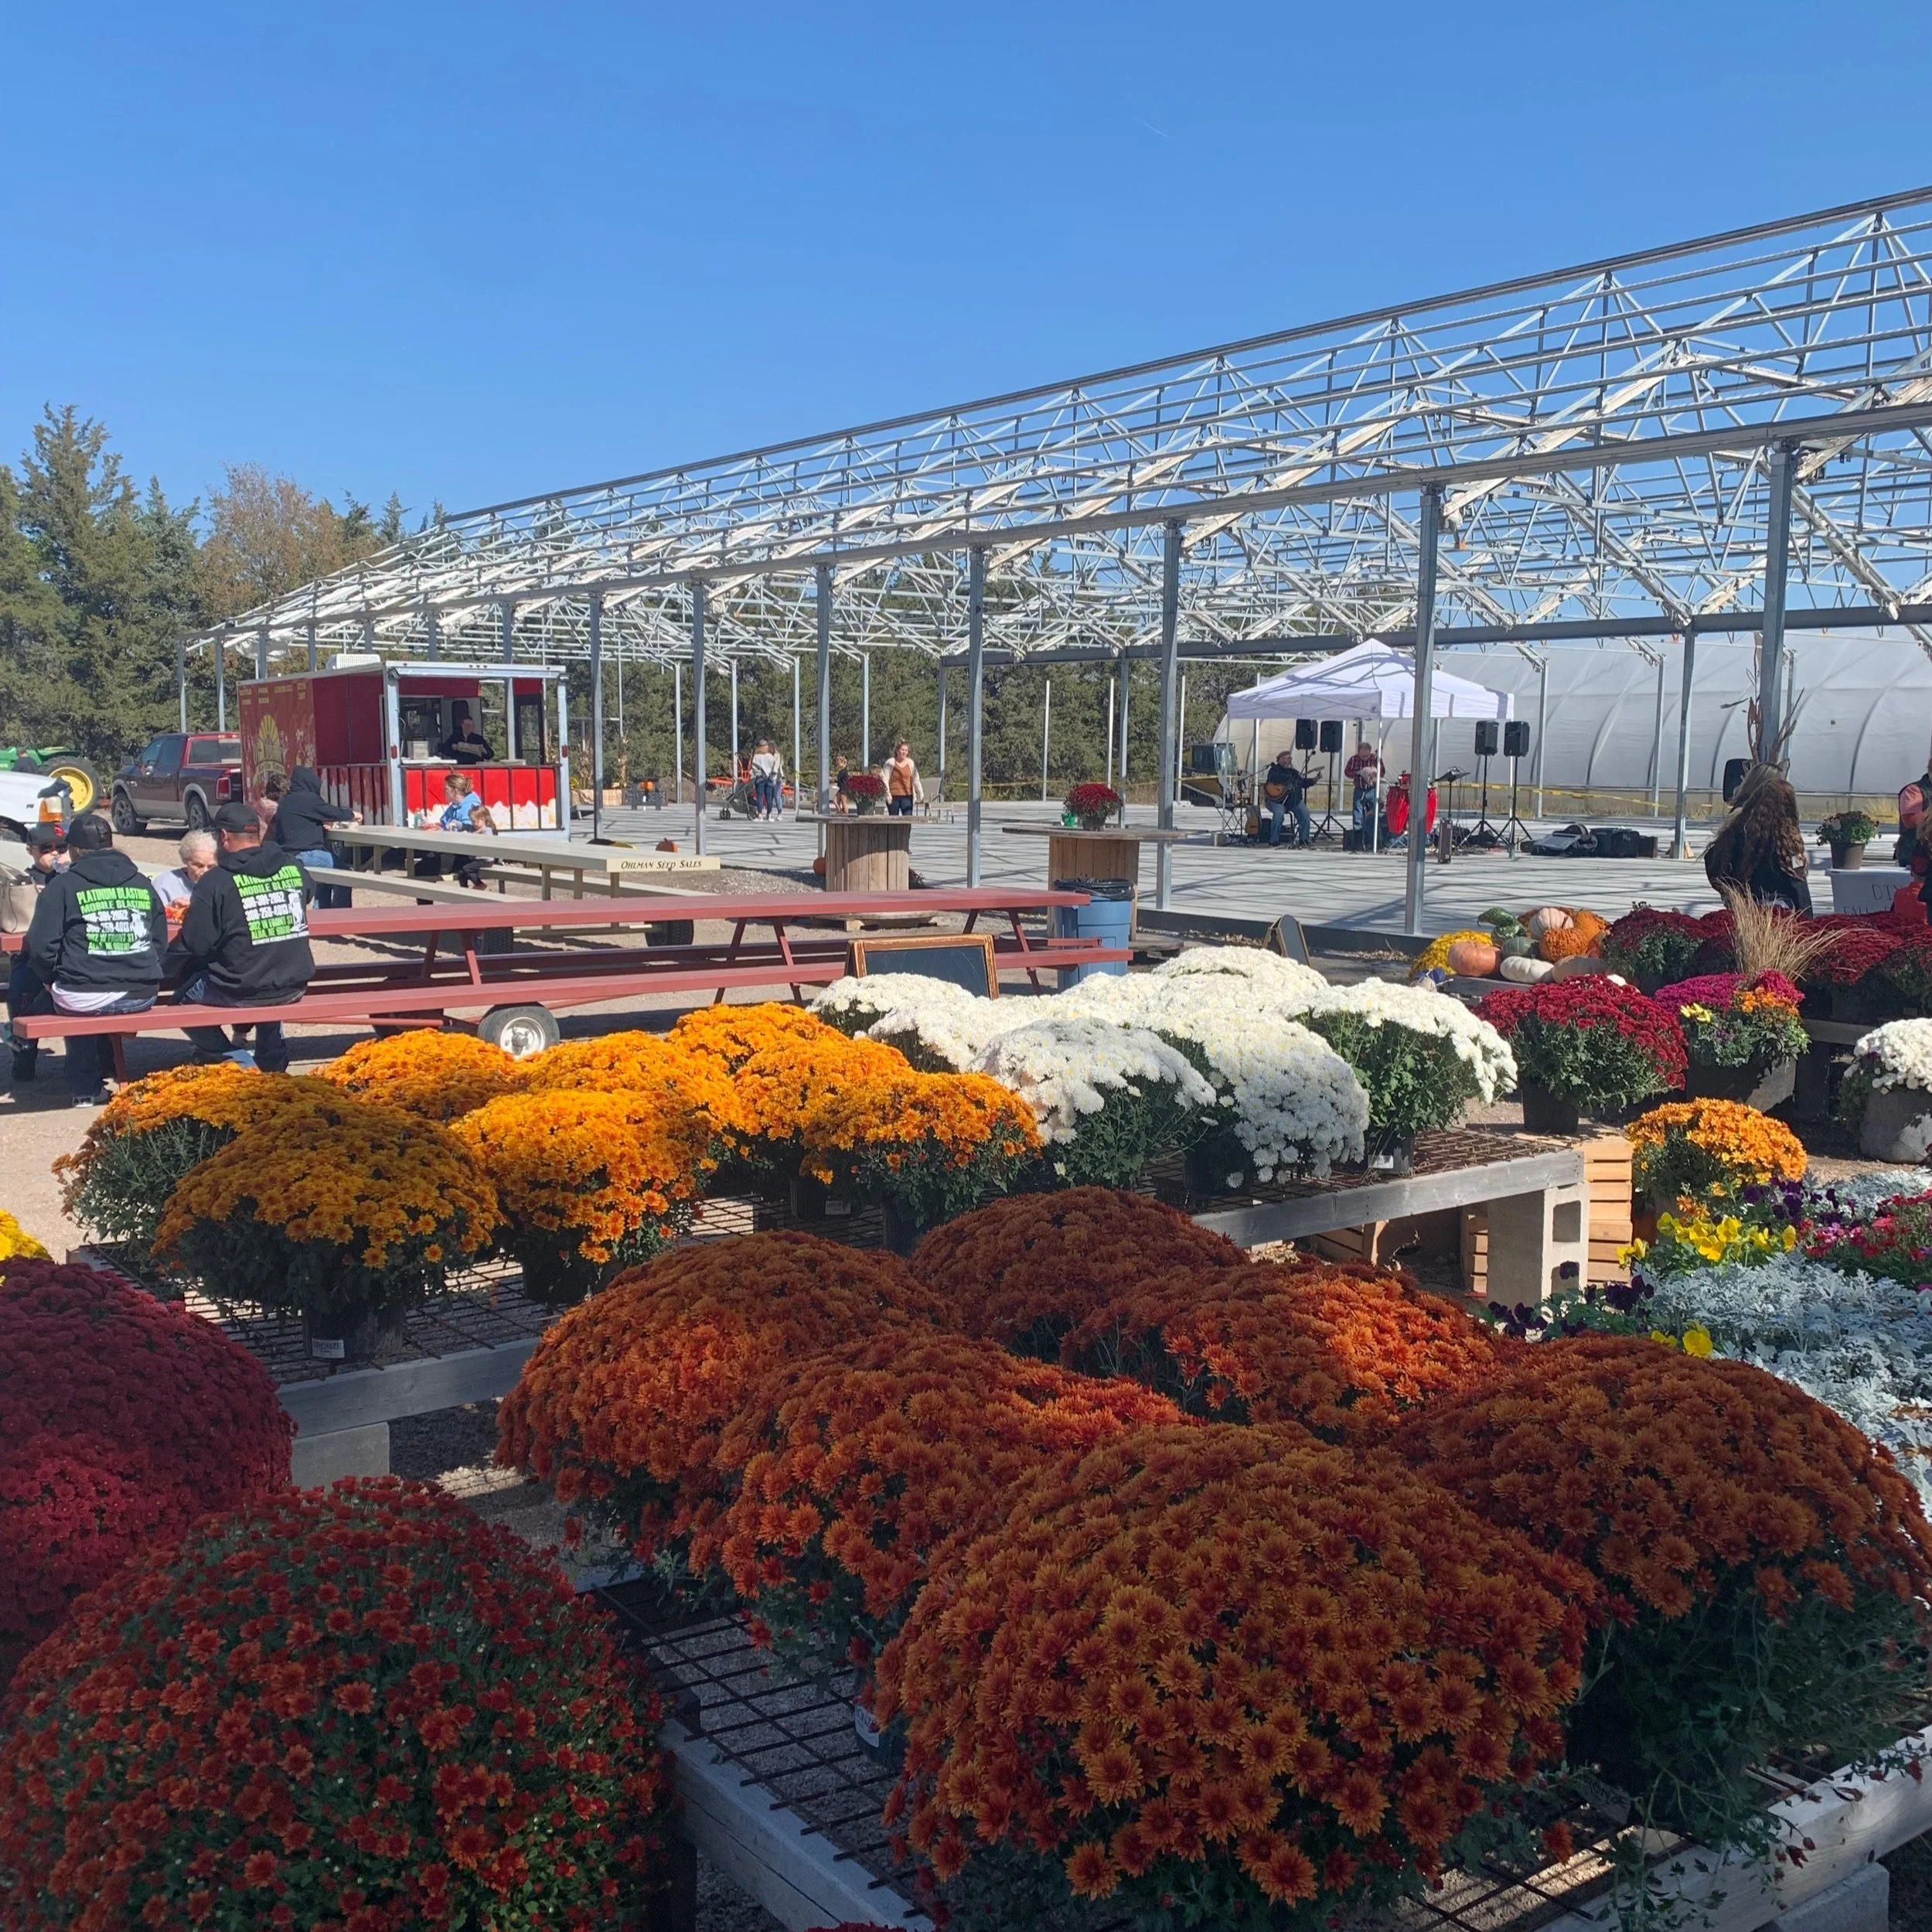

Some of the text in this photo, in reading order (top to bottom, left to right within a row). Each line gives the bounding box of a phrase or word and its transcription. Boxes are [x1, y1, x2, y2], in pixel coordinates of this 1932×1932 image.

[621, 860, 702, 869] OHLMAN SEED SALES
[238, 878, 303, 898] MOBILE BLASTING
[77, 888, 150, 905] PLATINUM BLASTING
[80, 900, 151, 915] MOBILE BLASTING
